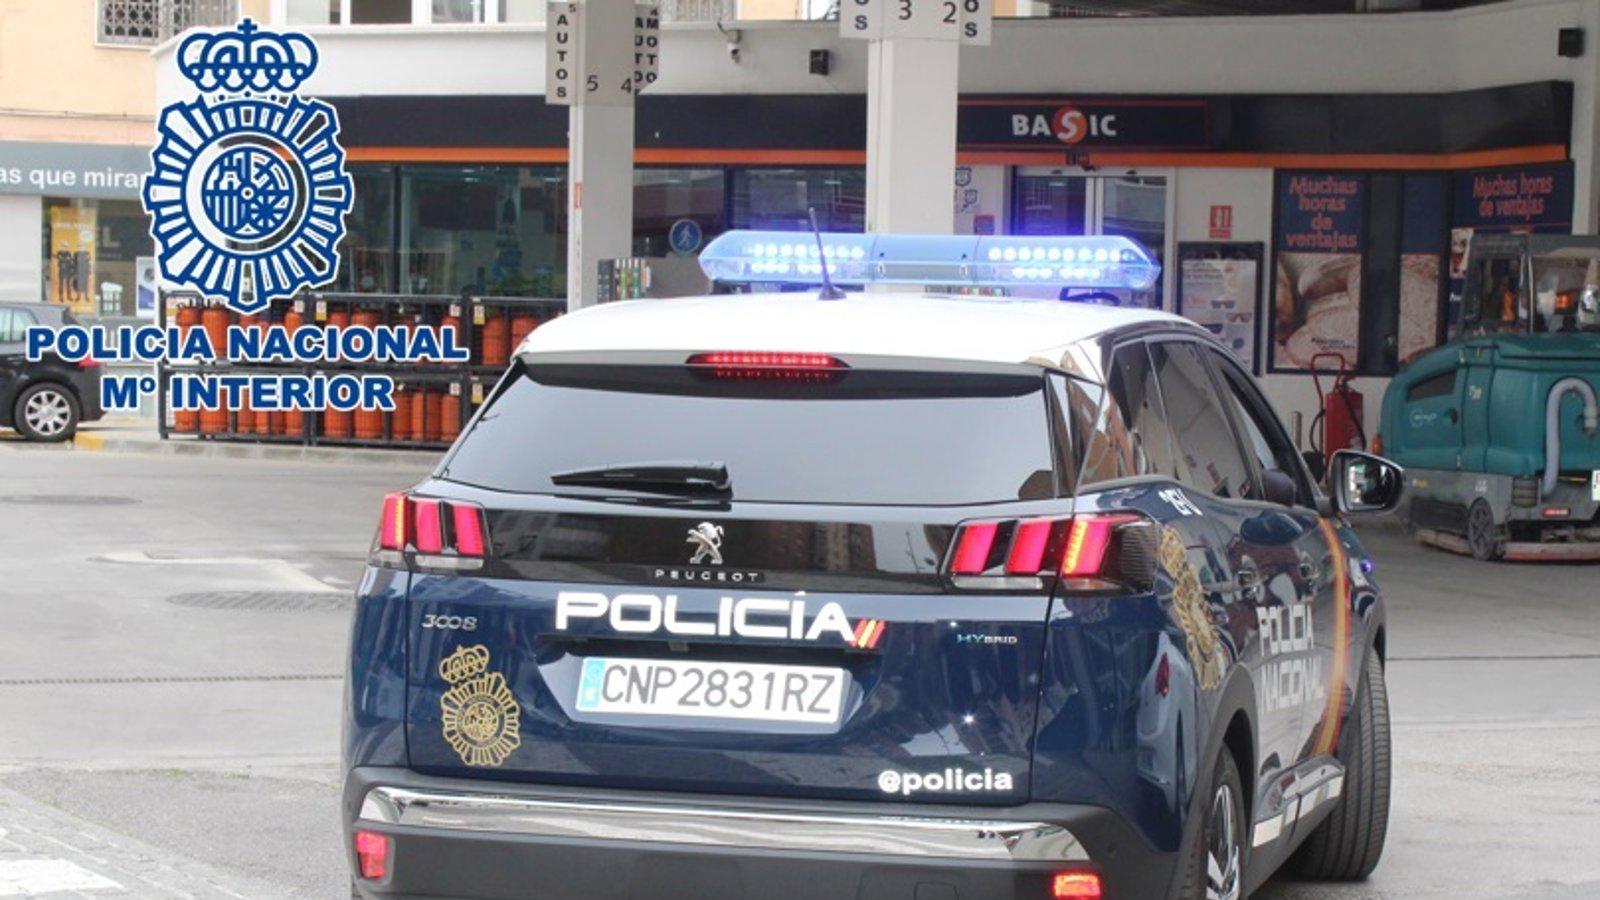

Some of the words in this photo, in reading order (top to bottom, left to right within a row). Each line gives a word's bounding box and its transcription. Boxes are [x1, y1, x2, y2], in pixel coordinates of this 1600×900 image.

[898, 0, 912, 21] 3
[943, 2, 956, 24] 2
[556, 14, 568, 98] AUTOS
[586, 75, 598, 92] 5
[620, 78, 632, 93] 4
[1011, 110, 1118, 142] BASIC
[29, 169, 77, 190] que
[1289, 176, 1358, 195] Muchas
[1472, 175, 1518, 198] Muchas
[1520, 172, 1554, 195] horas
[1299, 195, 1346, 212] horas
[1479, 195, 1495, 218] de
[1497, 196, 1545, 221] ventajas
[1311, 211, 1333, 230] de
[1286, 230, 1358, 252] ventajas
[654, 568, 759, 582] PEUGEOT
[422, 614, 478, 631] 3008
[554, 591, 855, 642] POLICÍA
[956, 633, 1018, 645] HYBRID
[877, 767, 1014, 796] @policia
